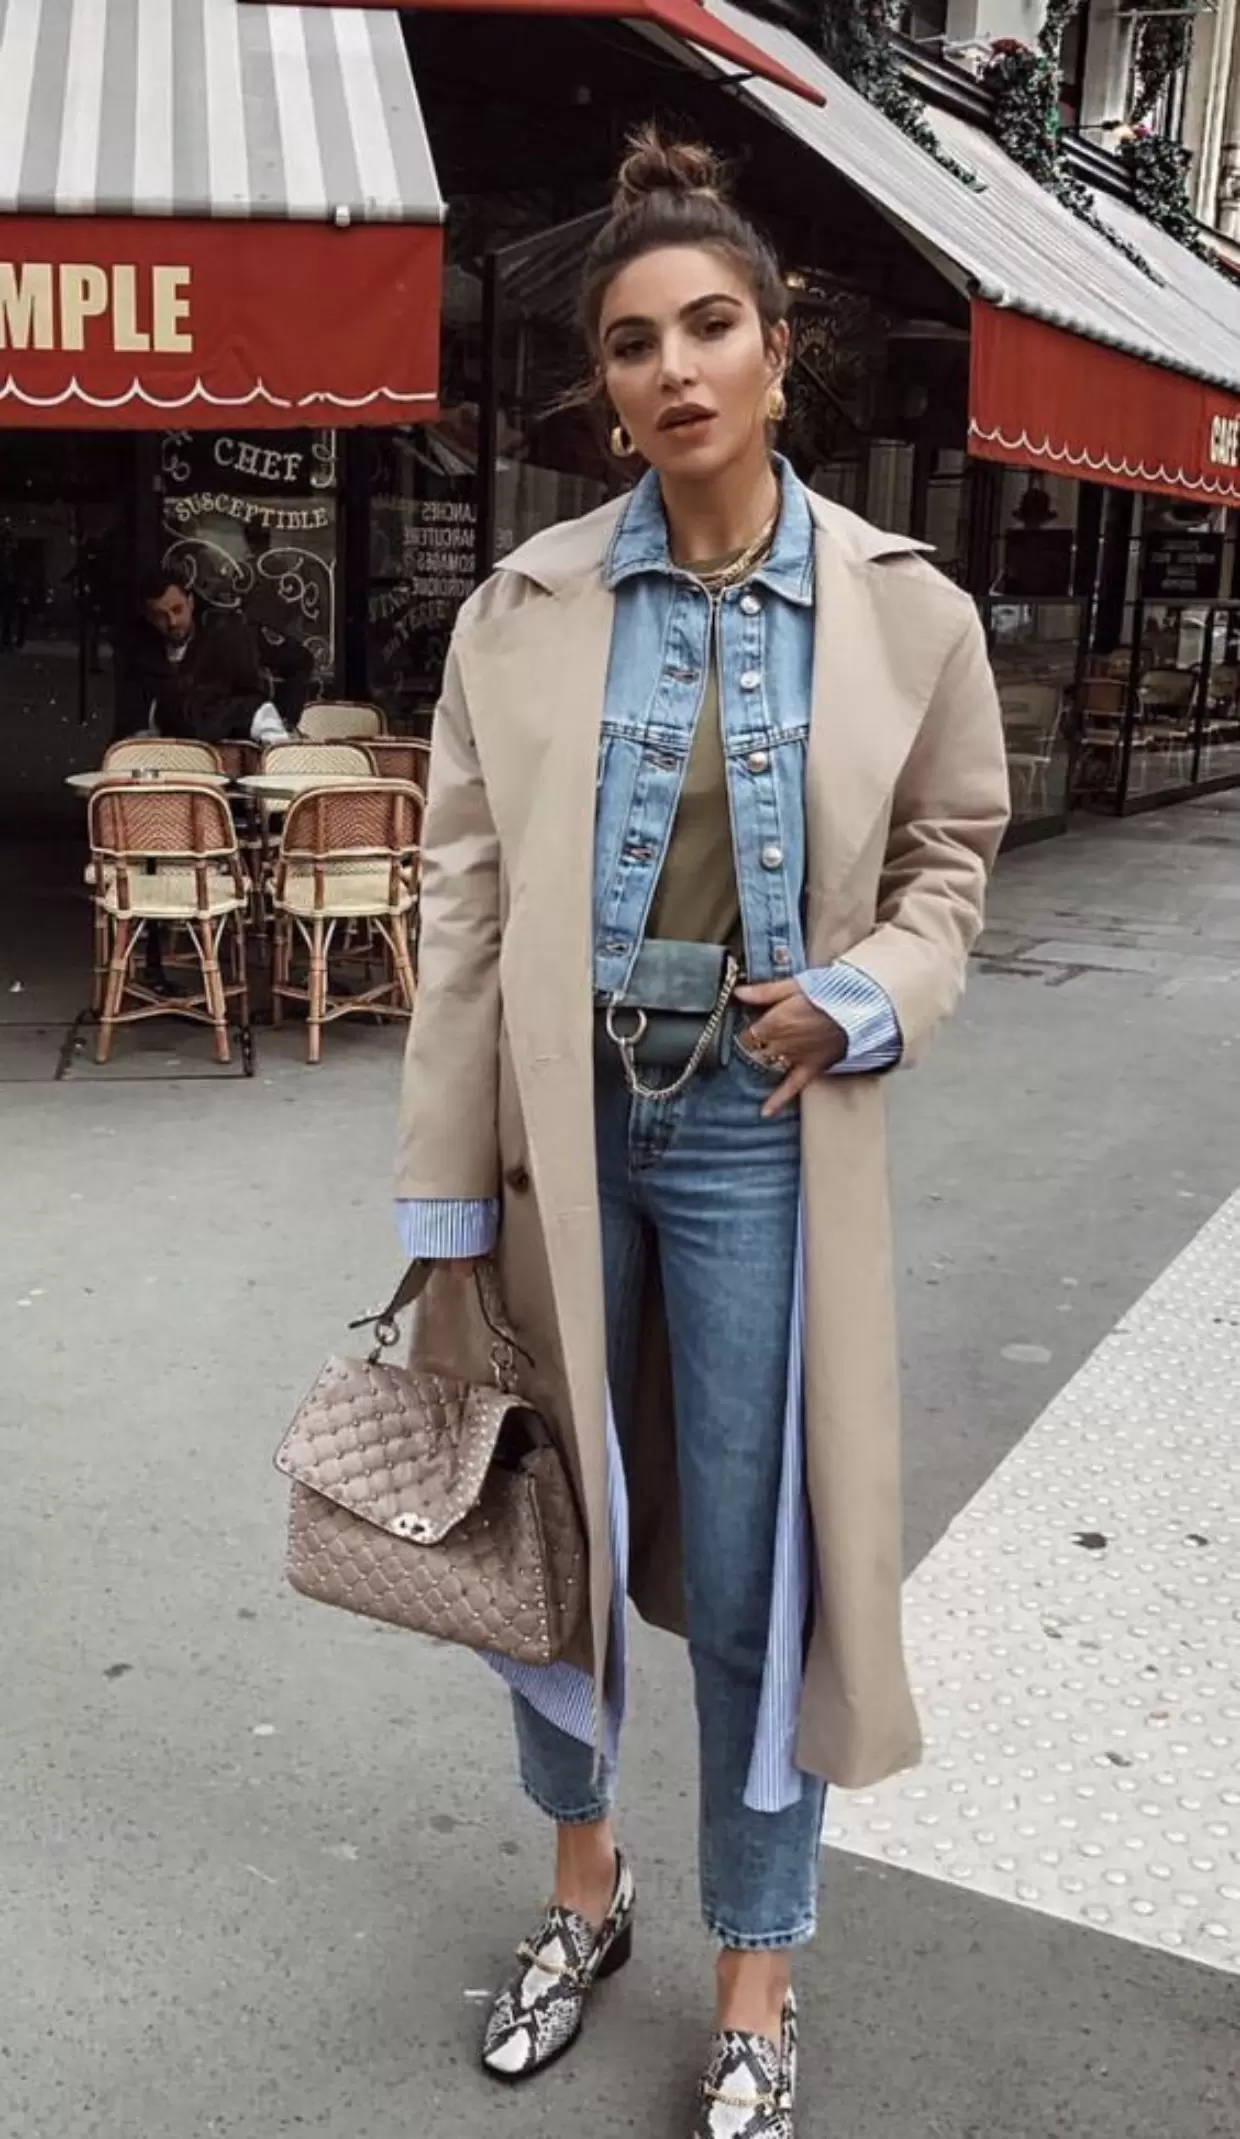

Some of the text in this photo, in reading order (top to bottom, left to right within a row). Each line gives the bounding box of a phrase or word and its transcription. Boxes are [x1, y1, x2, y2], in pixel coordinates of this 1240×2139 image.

[0, 262, 193, 353] MPLE
[214, 437, 304, 481] CHEF
[175, 492, 328, 529] SUSCEPTIBLE
